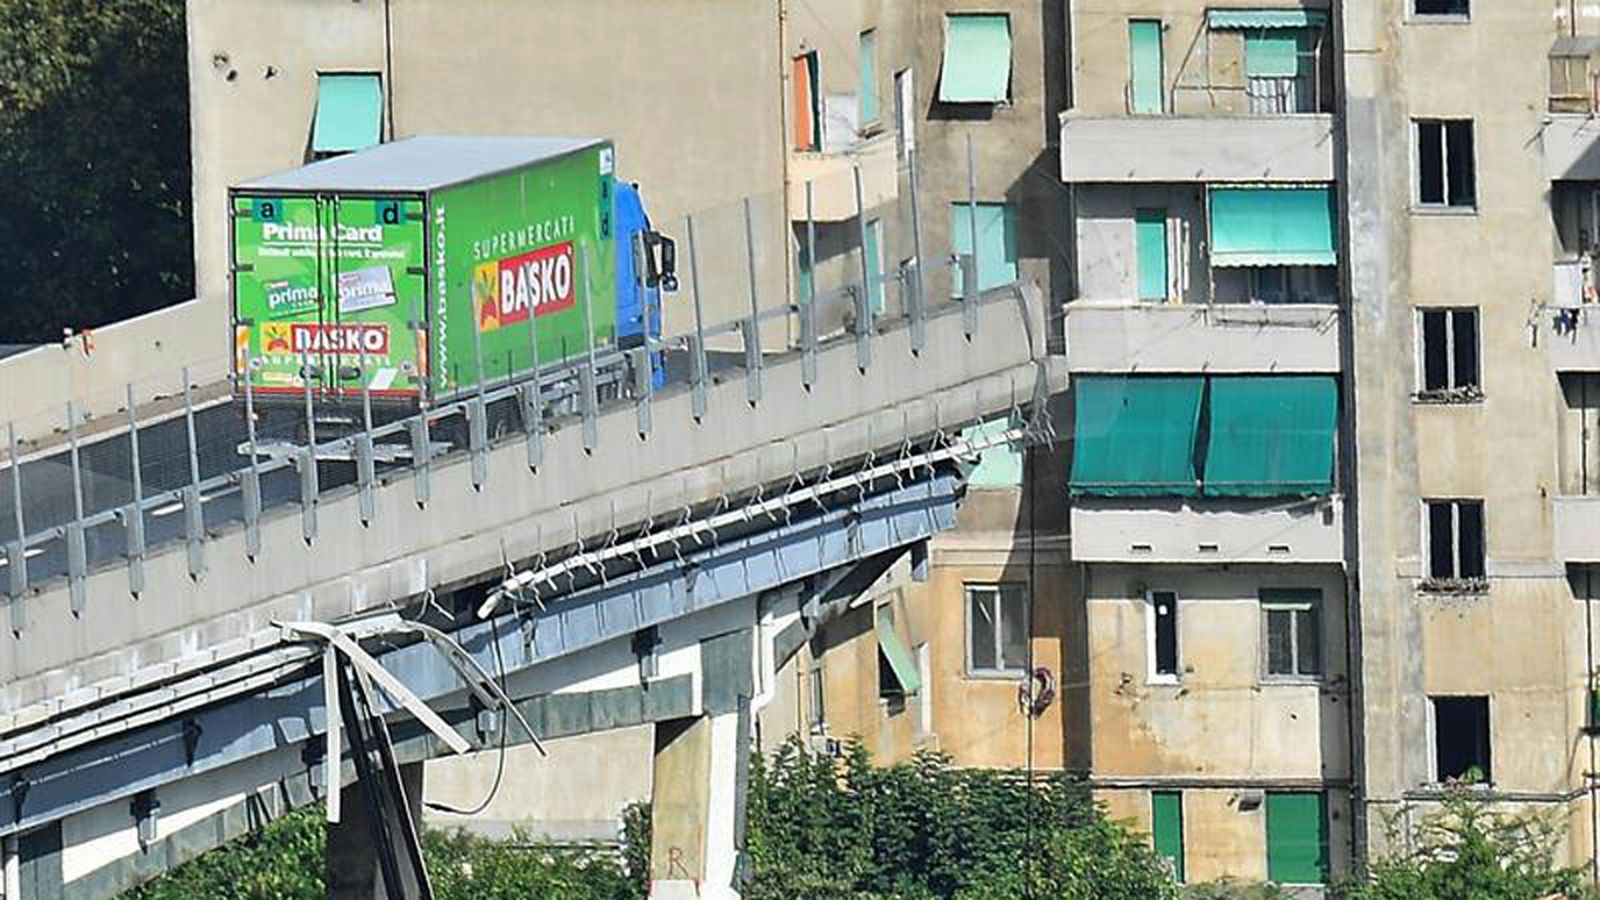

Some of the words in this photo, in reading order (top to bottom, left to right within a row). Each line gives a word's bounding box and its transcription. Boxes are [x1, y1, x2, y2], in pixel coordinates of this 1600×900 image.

[260, 202, 274, 218] a
[383, 202, 398, 224] d
[262, 221, 327, 241] Prima
[331, 222, 383, 241] Card
[473, 215, 575, 259] SUPERMERCATI
[436, 207, 448, 388] www.basko.it
